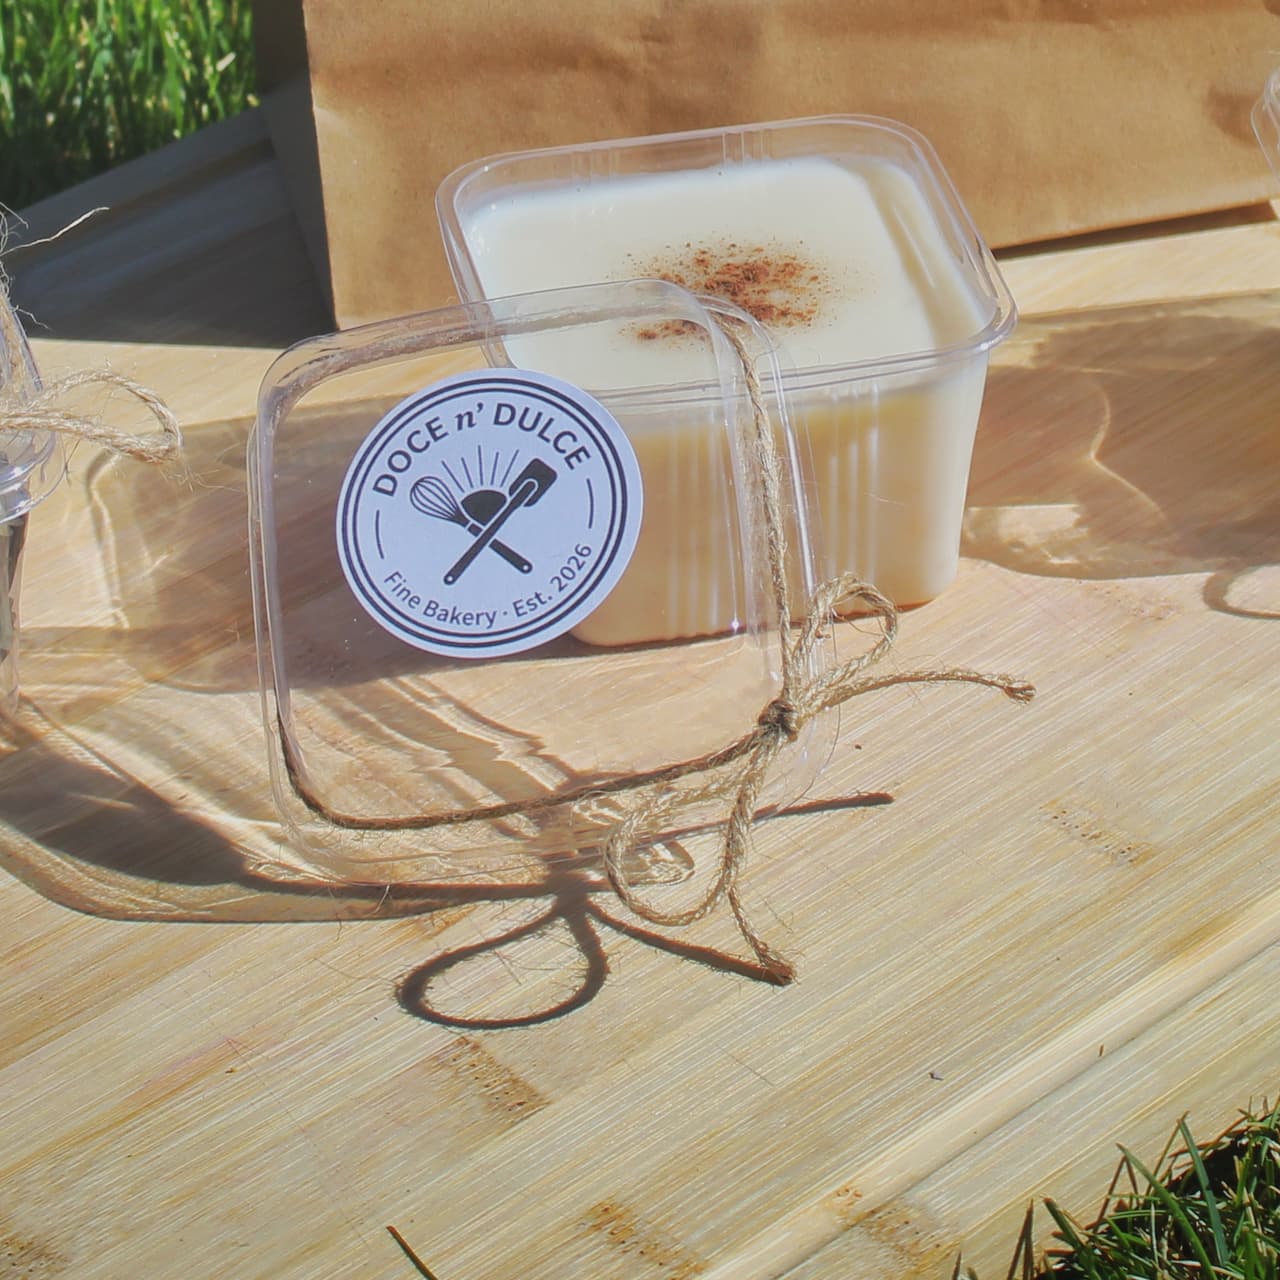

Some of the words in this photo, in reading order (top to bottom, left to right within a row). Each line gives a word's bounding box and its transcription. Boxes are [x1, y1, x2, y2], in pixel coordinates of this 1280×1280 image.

[372, 416, 449, 496] DOCE
[493, 403, 591, 470] DULCE
[384, 570, 420, 608] Fine
[423, 600, 497, 629] Bakery
[512, 591, 552, 617] Est.
[550, 543, 591, 592] 2026
